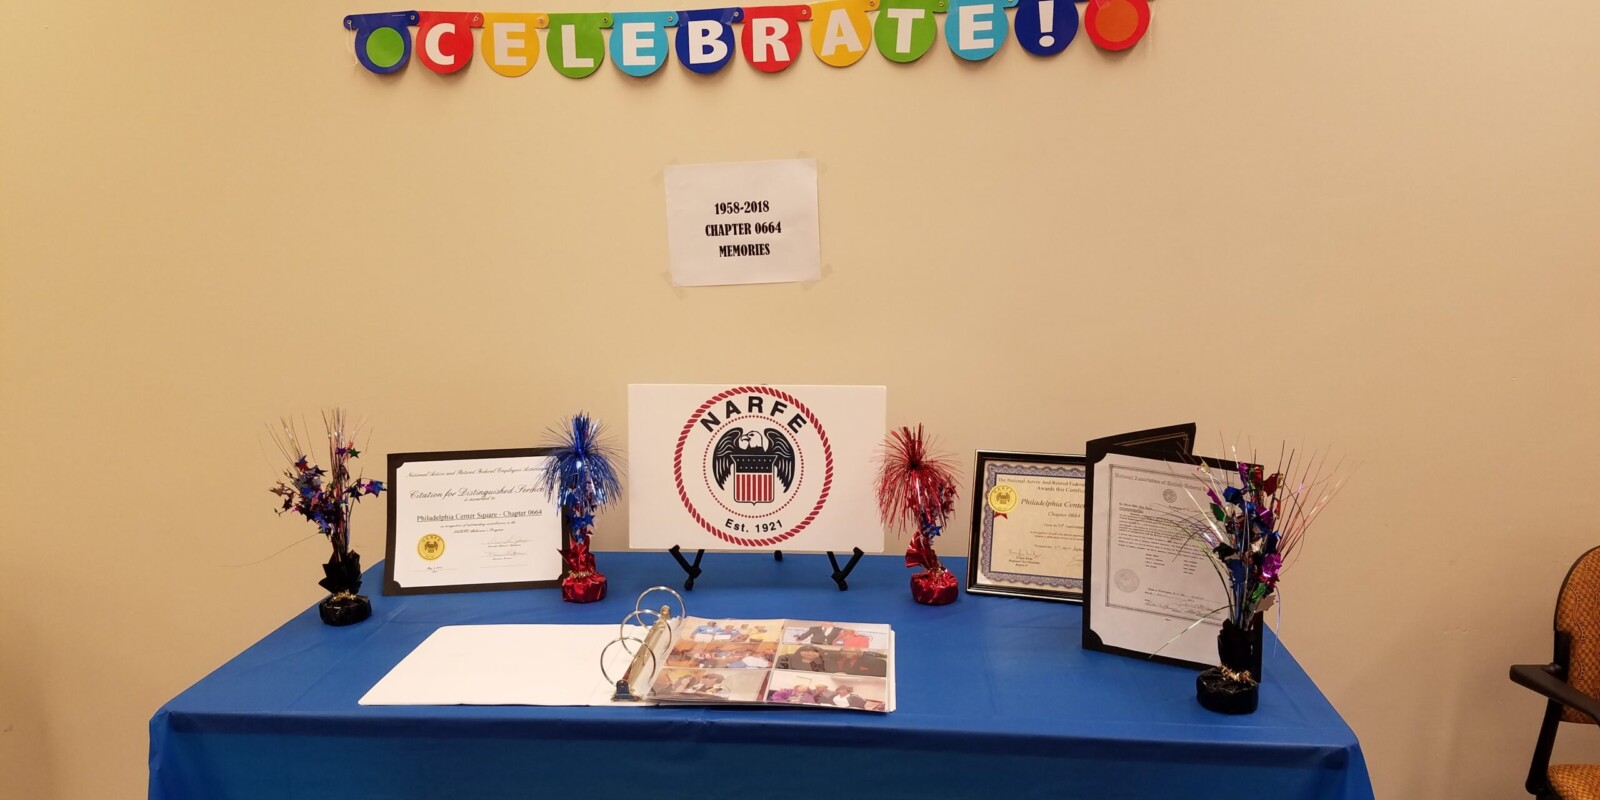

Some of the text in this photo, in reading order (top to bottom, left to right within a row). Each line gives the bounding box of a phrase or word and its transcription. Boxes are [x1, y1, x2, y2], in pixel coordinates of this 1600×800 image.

[425, 0, 1055, 68] CELEBRATE!
[715, 200, 769, 214] 1958-2018
[705, 221, 782, 236] CHAPTER 0664
[719, 243, 770, 257] MEMORIES
[700, 396, 807, 433] NARFE
[409, 489, 443, 499] Citation
[442, 488, 457, 500] for
[457, 485, 515, 498] Distinguished
[1021, 498, 1063, 508] Philadelphia
[416, 513, 454, 522] Philadelphia
[454, 512, 476, 520] Center
[476, 511, 498, 520] Square
[502, 509, 527, 518] Chapter
[725, 518, 783, 533] Est. 1921
